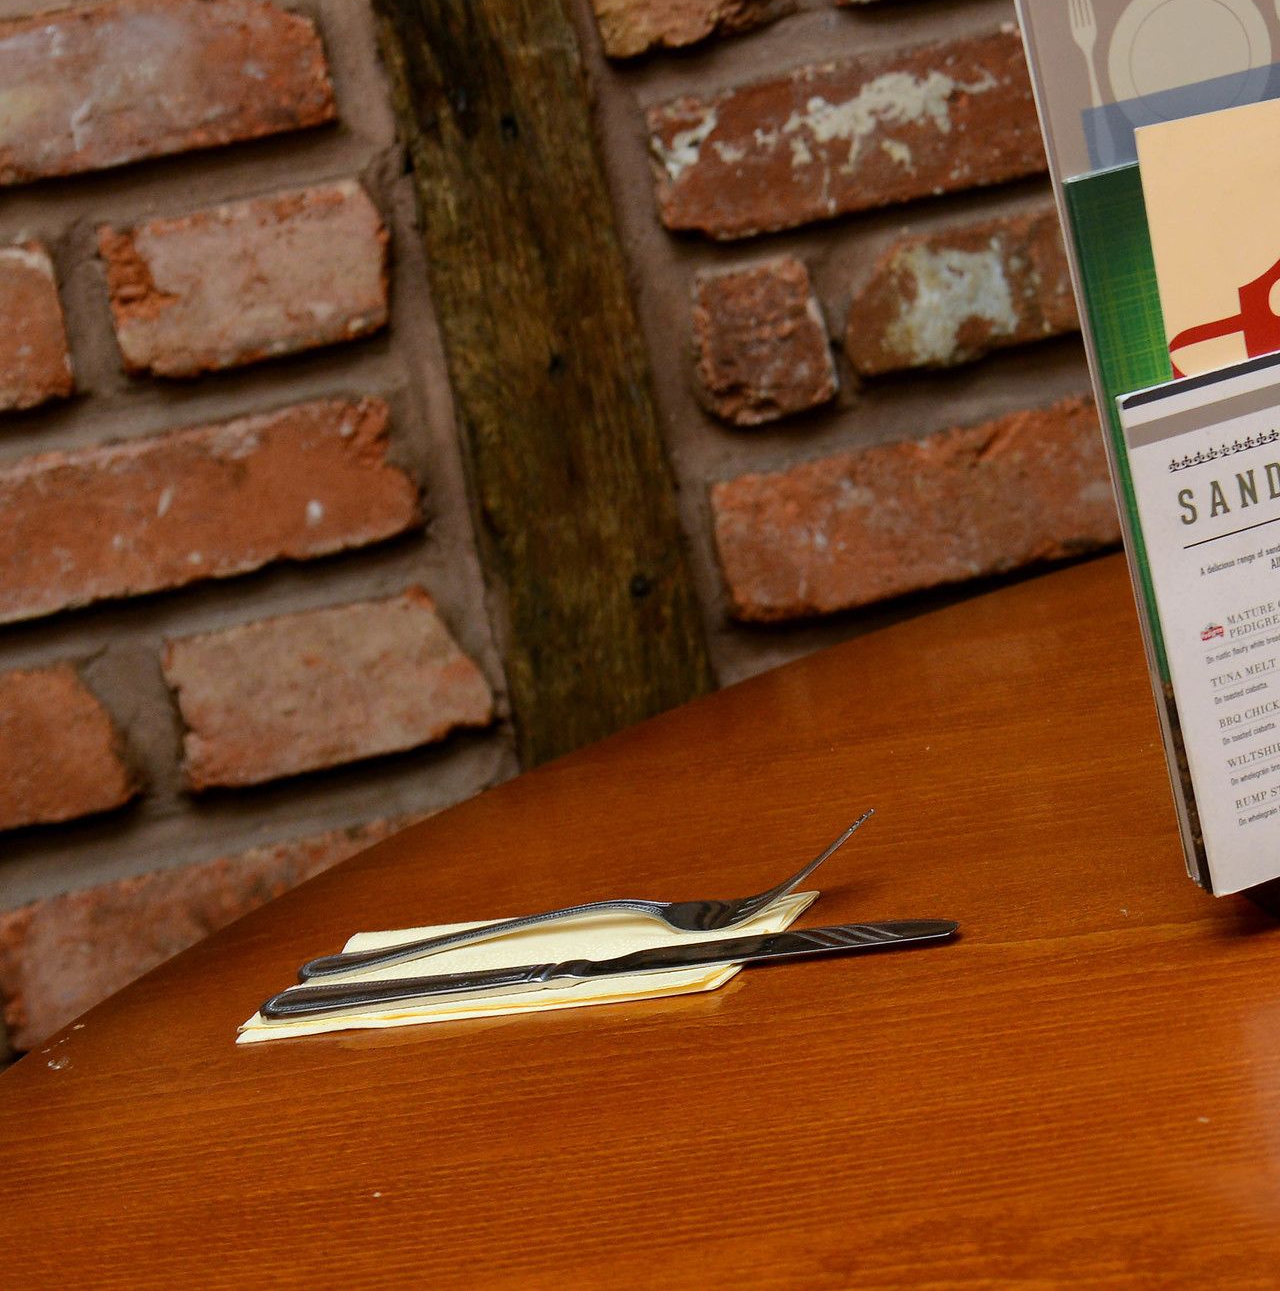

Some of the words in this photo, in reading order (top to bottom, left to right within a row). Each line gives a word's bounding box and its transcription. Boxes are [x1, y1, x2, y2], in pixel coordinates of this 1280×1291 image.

[1226, 599, 1275, 625] MATURE
[1210, 671, 1242, 687] TUNA
[1245, 658, 1276, 675] MELT
[1219, 713, 1242, 728] BBQ
[1235, 791, 1267, 809] RUMP
